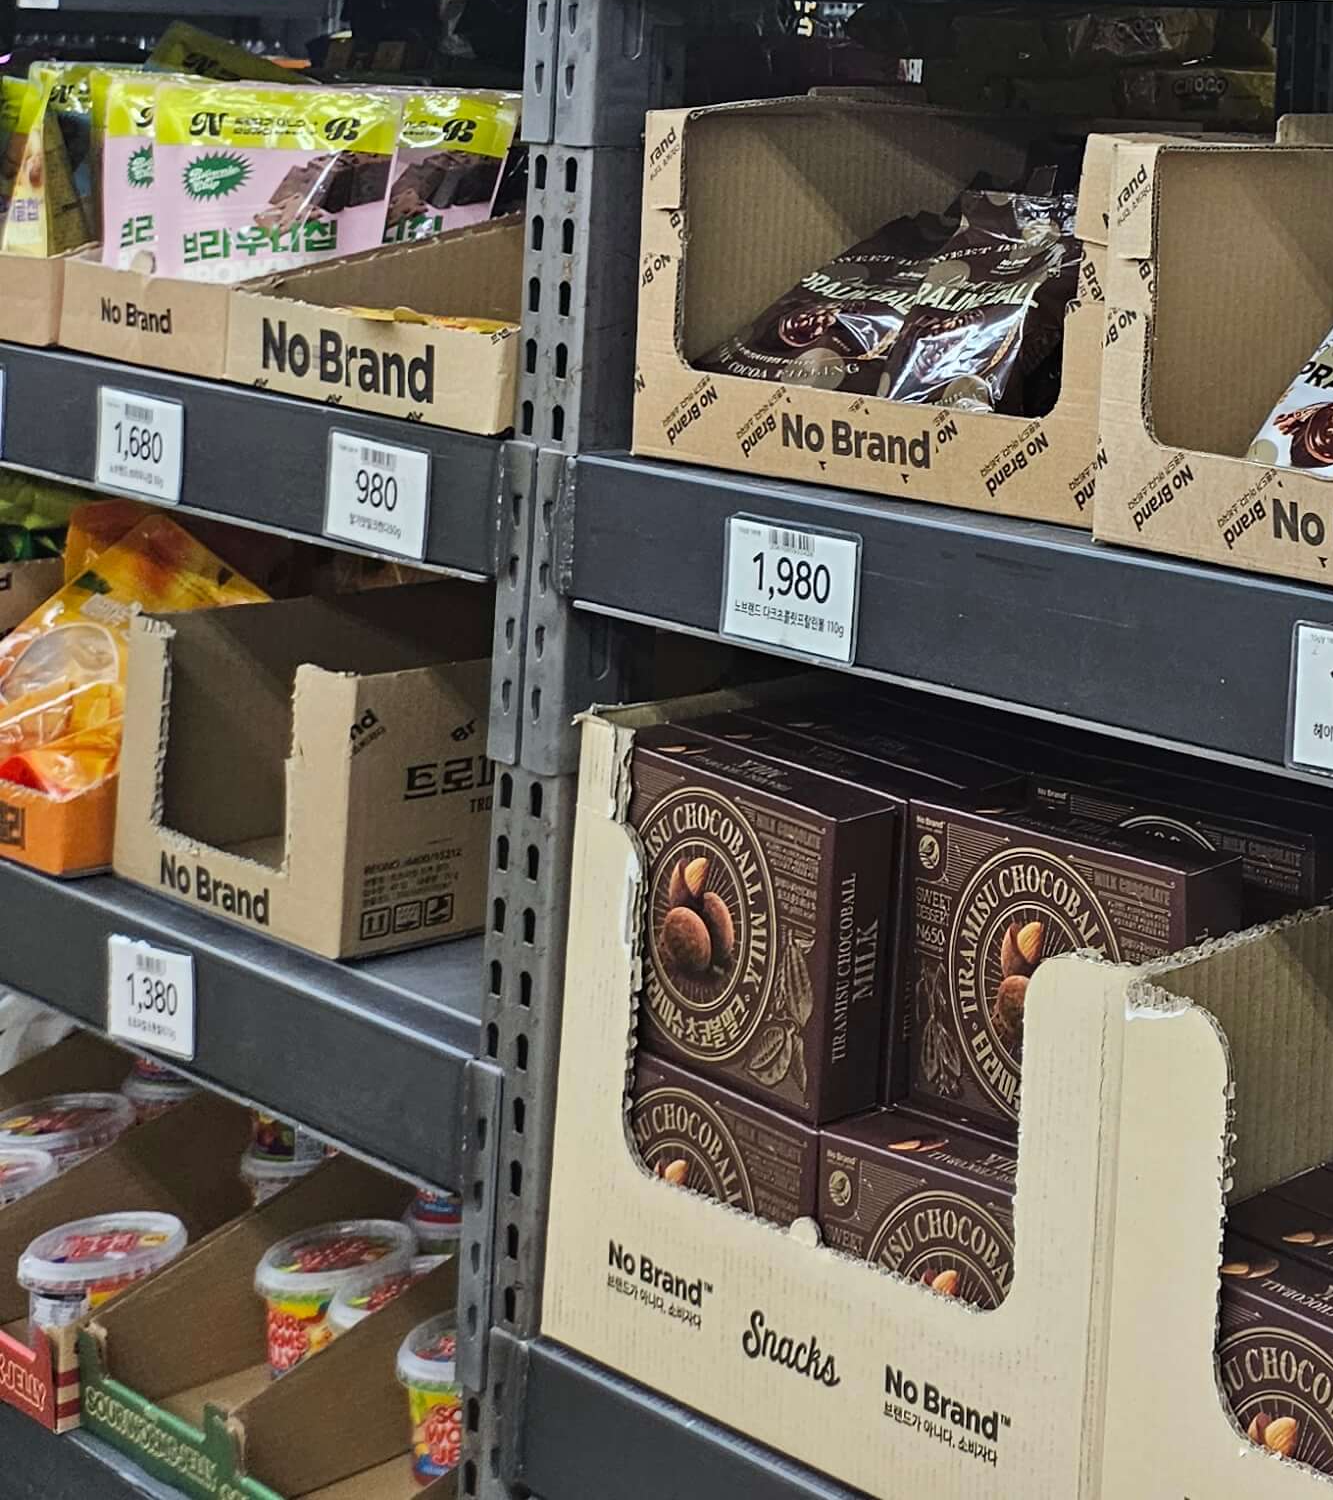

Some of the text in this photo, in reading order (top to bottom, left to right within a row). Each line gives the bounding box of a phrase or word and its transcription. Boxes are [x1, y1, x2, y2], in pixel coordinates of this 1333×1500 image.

[184, 219, 337, 263] 브라우니칩
[100, 297, 172, 334] No Brand
[261, 317, 435, 403] No Brand
[114, 422, 163, 464] 1,680
[781, 412, 931, 469] No Brand
[355, 469, 398, 511] 980
[753, 551, 831, 604] 1,980
[827, 619, 844, 638] 110g
[160, 851, 270, 926] No Brand
[831, 872, 858, 1063] TIRAMISU CHOCOBALL
[852, 918, 880, 1002] MILK
[126, 972, 178, 1016] 1,380
[742, 1309, 841, 1388] Snacks
[885, 1365, 999, 1443] No Brand
[883, 1400, 922, 1434] 브랜드가
[958, 1430, 998, 1469] 소비자다
